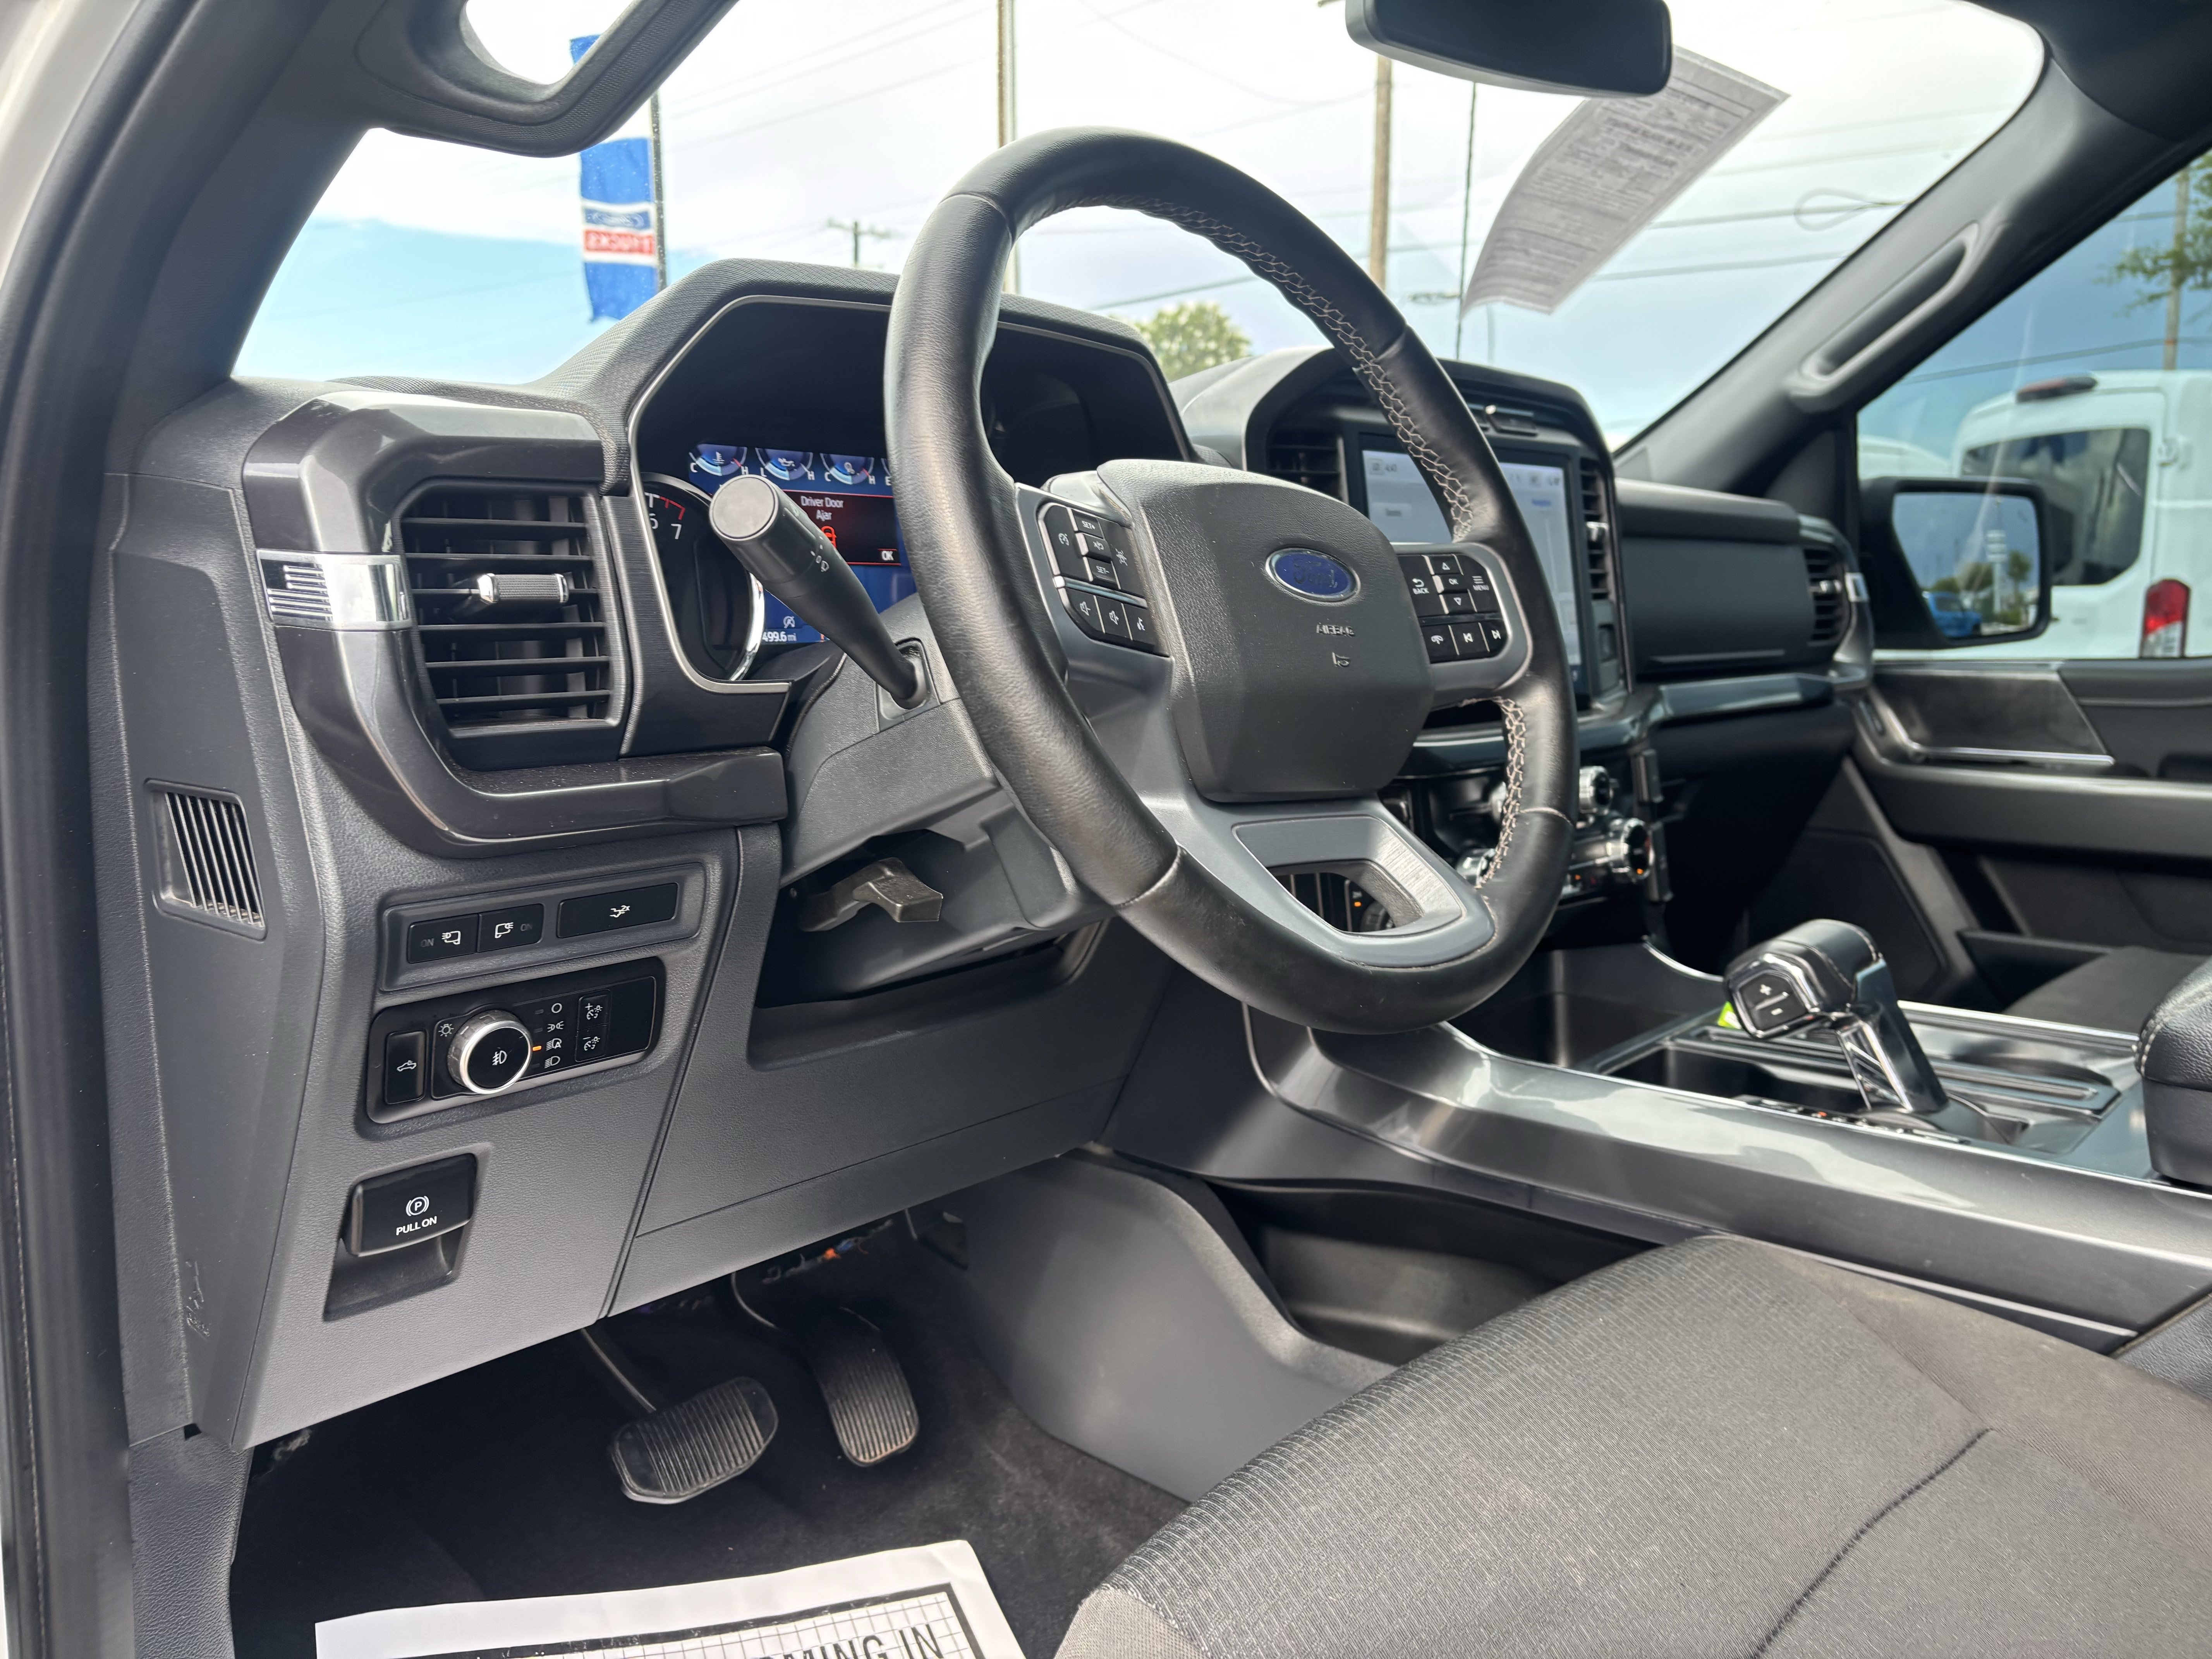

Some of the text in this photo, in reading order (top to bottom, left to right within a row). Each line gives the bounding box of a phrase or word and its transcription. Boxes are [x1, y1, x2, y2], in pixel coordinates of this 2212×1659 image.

[800, 496, 843, 508] Driver Door
[816, 510, 832, 521] Ajar
[671, 524, 682, 539] 7
[881, 550, 894, 561] OK
[421, 938, 434, 947] ON
[396, 1216, 437, 1236] PULL ON
